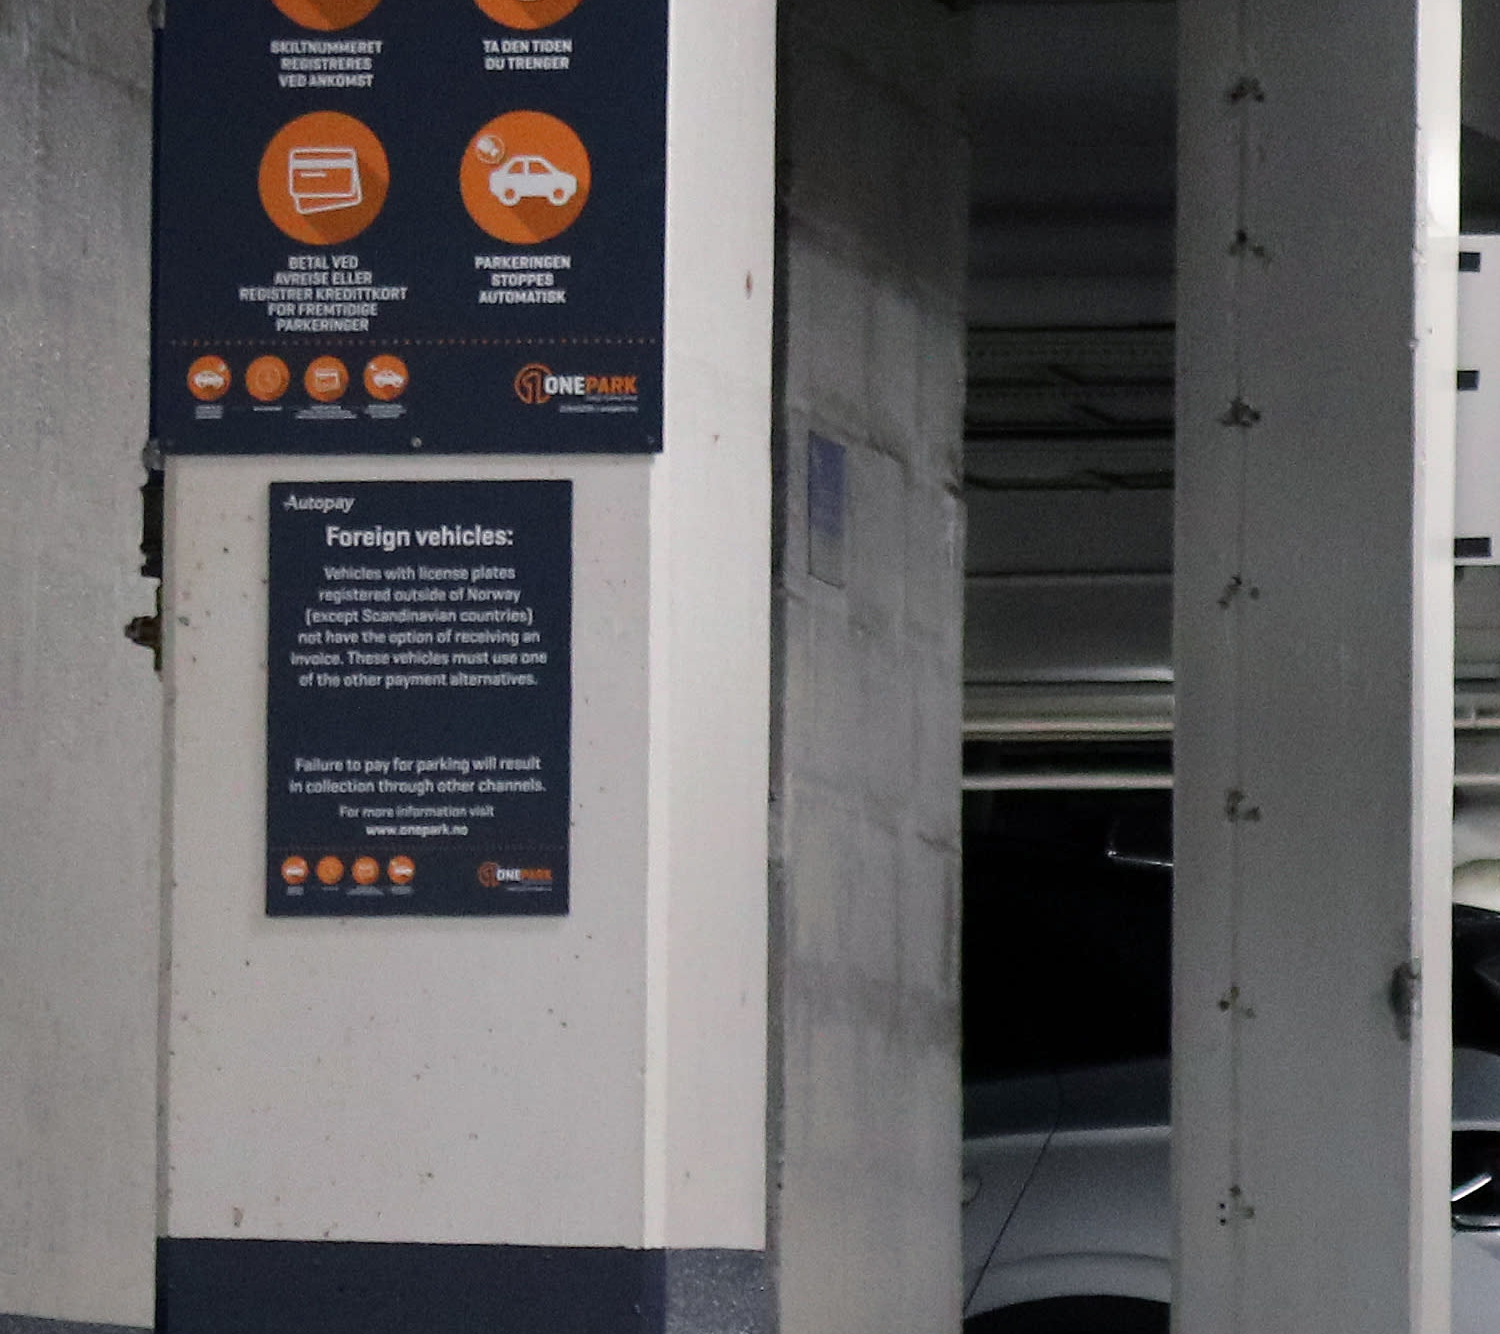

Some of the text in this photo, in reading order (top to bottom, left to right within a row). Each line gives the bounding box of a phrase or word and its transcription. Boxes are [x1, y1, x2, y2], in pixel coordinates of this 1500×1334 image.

[270, 40, 383, 54] SKILTNUMMERET
[483, 40, 573, 53] TA DEN TIDEN
[280, 57, 372, 71] REGISTRERES
[484, 56, 569, 70] DU TRENGER
[278, 74, 374, 87] VED ANKOMST
[288, 256, 358, 269] BETAL VED
[475, 255, 571, 269] PARKERINGEN
[274, 271, 372, 285] AVREISE ELLER
[491, 273, 554, 286] STOPPES
[239, 287, 408, 302] REGISTRER KREDITTKORT
[479, 290, 566, 304] AUTOMATISK
[299, 303, 378, 317] FREMTIDIGE
[277, 319, 369, 332] PARKERINGER
[544, 374, 638, 395] ONEPARK
[283, 495, 355, 513] Autopay
[325, 524, 515, 551] Foreign vehicles:
[324, 566, 516, 583] Vehicles with license plates
[318, 588, 521, 605] registered outside of Norway
[361, 608, 457, 622] Scandinavian
[298, 631, 322, 644] not
[325, 630, 359, 644] have
[362, 630, 386, 644] the
[388, 630, 434, 646] option
[437, 630, 453, 644] of
[454, 630, 519, 647] receiving
[347, 651, 390, 665] These
[392, 650, 449, 665] vehicles
[451, 652, 490, 665] must
[492, 653, 517, 665] use
[316, 673, 340, 687] the
[343, 673, 382, 687] other
[385, 673, 448, 690] payment
[295, 756, 542, 775] Failure to pay for parking will result
[305, 779, 374, 794] collection
[378, 779, 434, 796] through
[436, 779, 476, 793] other
